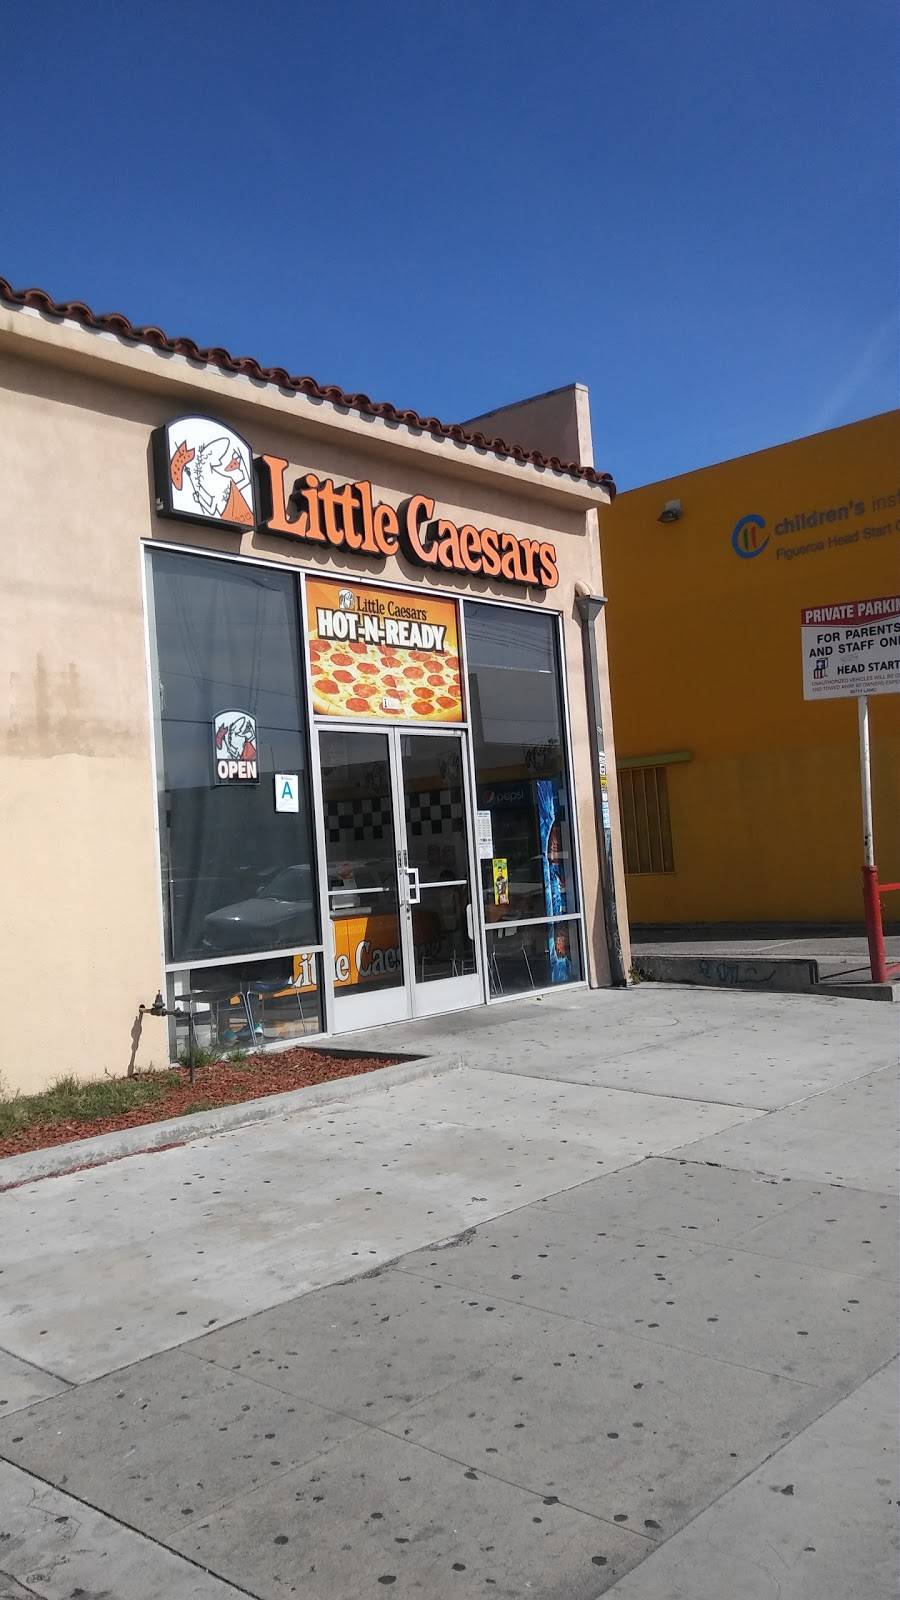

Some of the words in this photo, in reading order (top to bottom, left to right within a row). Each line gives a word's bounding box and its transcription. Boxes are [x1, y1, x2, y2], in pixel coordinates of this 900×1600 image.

[262, 454, 400, 557] Little
[406, 495, 559, 589] Caesars
[774, 500, 865, 536] children's
[828, 530, 859, 548] Head
[863, 523, 892, 540] Start
[356, 596, 386, 617] Little
[387, 601, 427, 621] Caesars
[805, 604, 855, 624] PRIVATE
[317, 608, 446, 652] HOT-N-READY
[817, 632, 840, 644] FOR
[846, 623, 900, 640] PARENTS
[809, 646, 833, 658] AND
[838, 639, 875, 653] STAFF
[837, 663, 865, 675] HEAD
[868, 659, 900, 672] START
[218, 760, 257, 779] OPEN
[282, 781, 294, 799] A
[497, 790, 524, 804] pepsi
